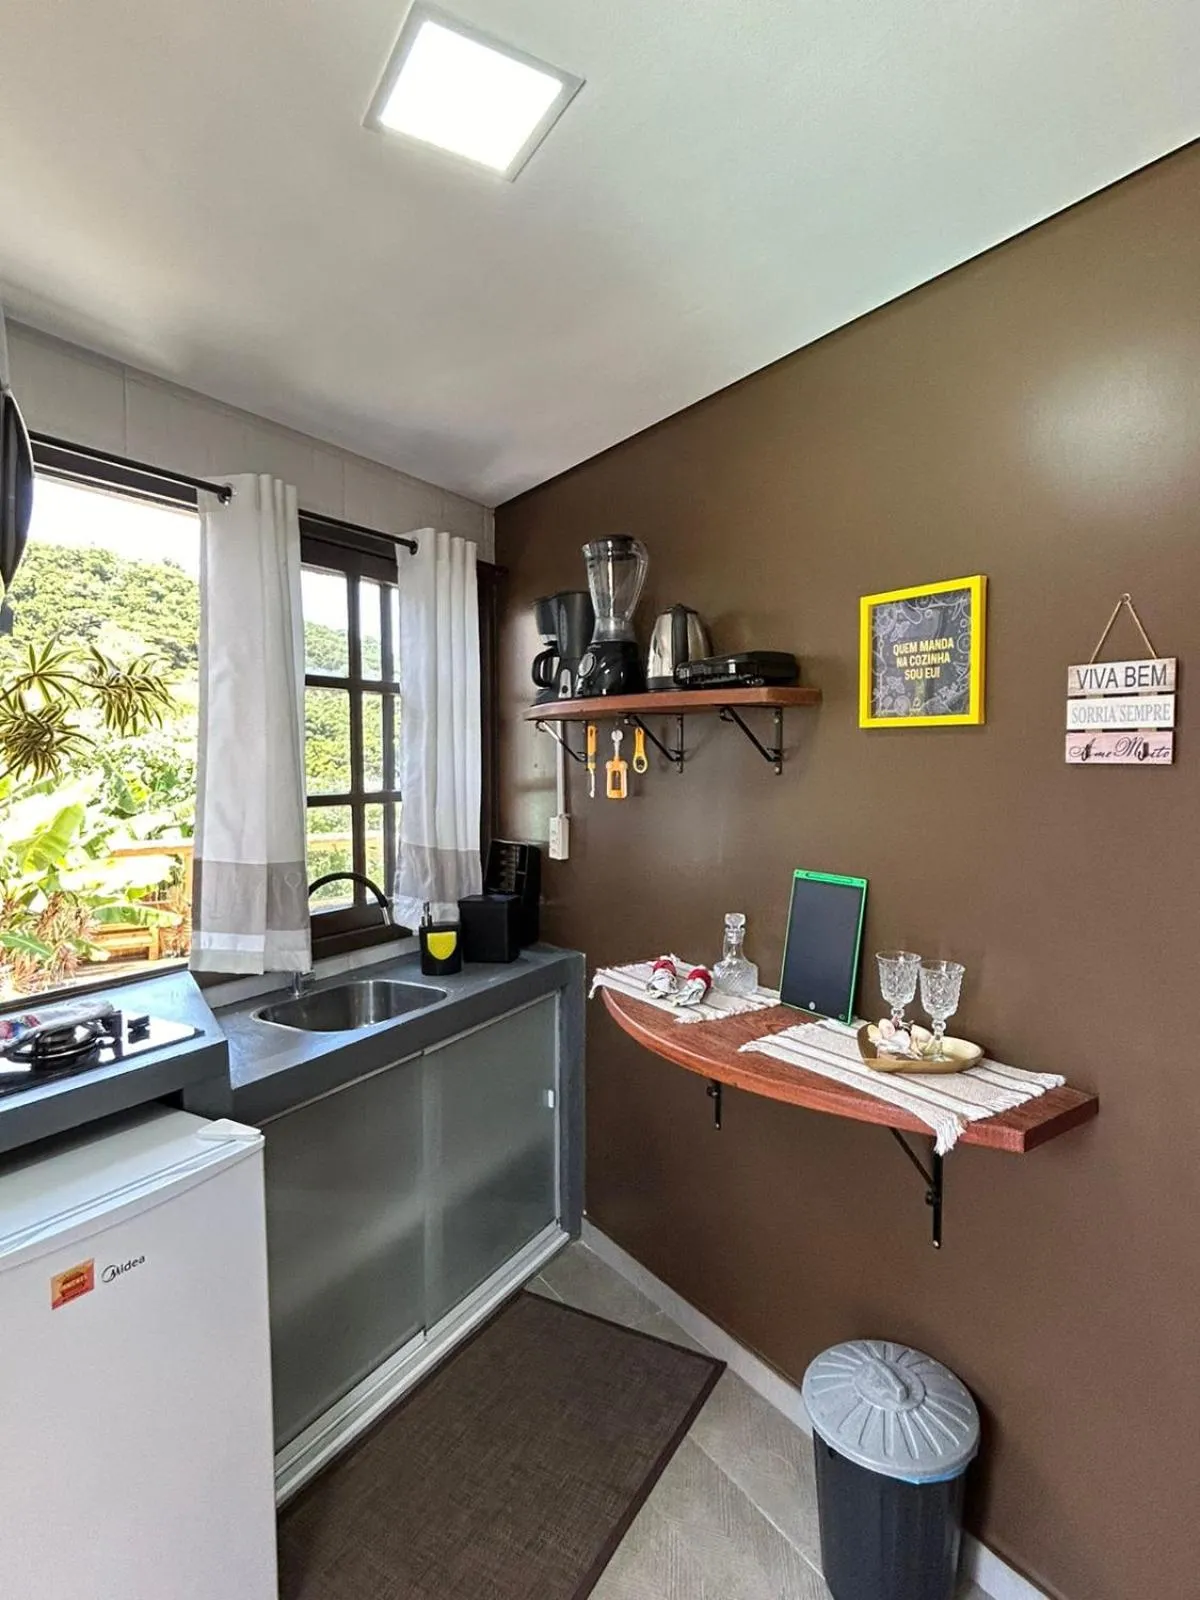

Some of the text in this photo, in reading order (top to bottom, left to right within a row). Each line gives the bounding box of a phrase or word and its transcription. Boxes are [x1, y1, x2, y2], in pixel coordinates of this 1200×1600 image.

[893, 637, 954, 656] QUEM MANDA
[896, 652, 951, 668] NA COZINHA
[904, 669, 924, 680] SOU
[1077, 664, 1167, 690] VIVA BEM
[1071, 703, 1171, 724] SORRIA SEMPRE
[102, 1255, 146, 1283] Midea
